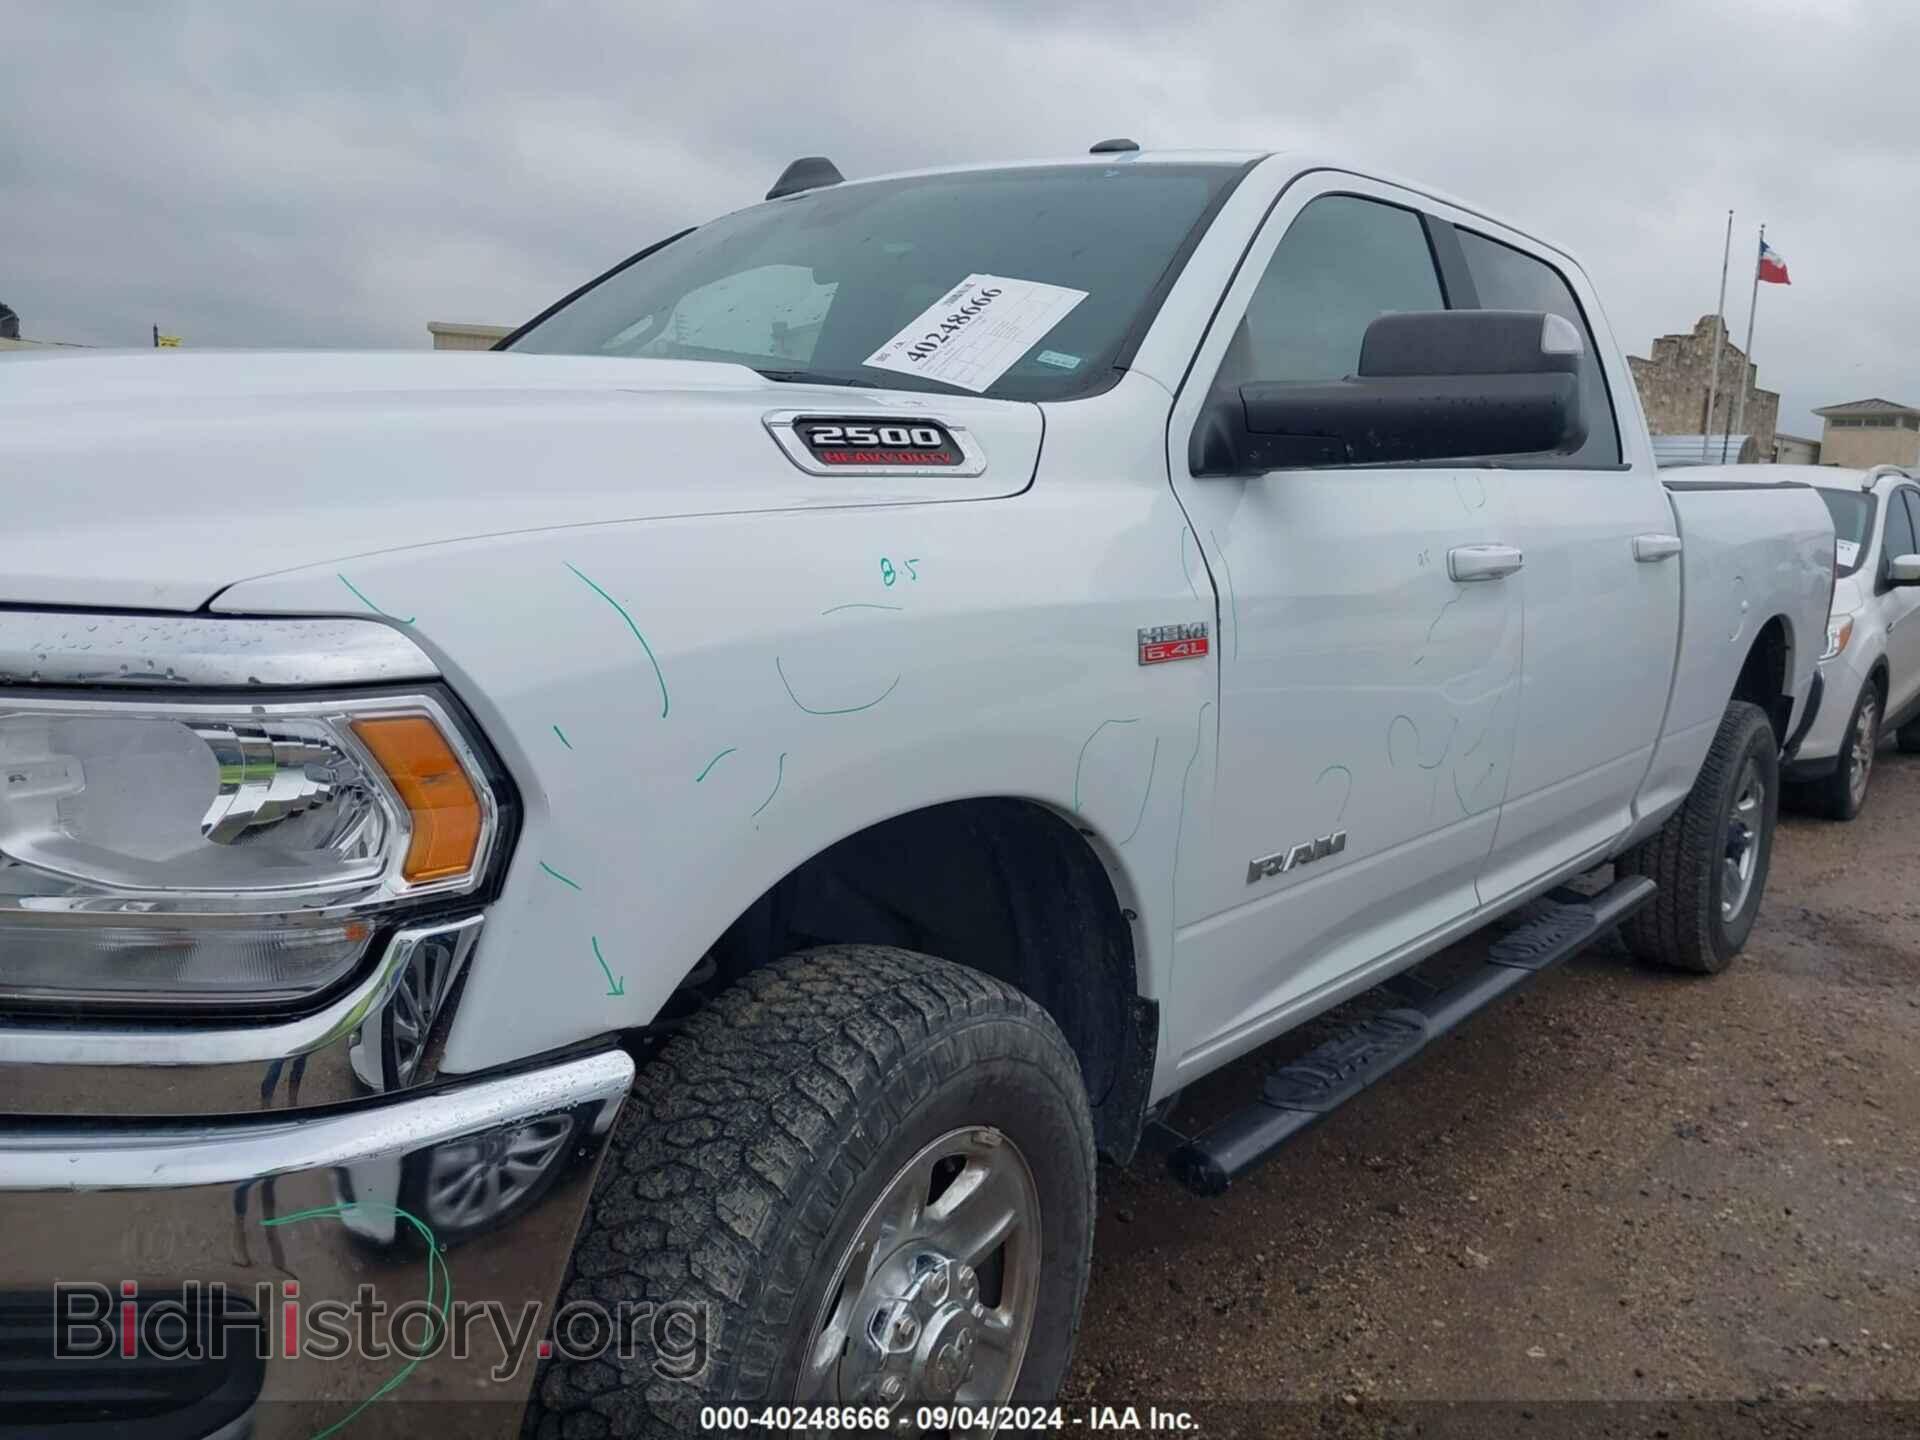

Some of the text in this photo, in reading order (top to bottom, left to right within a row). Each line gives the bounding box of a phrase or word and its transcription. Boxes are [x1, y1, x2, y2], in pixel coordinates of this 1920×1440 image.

[906, 288, 1002, 362] 40248666
[808, 427, 942, 447] 2500
[1138, 622, 1209, 645] HEMI
[1145, 641, 1208, 661] 6.4L
[1246, 830, 1347, 884] RAM
